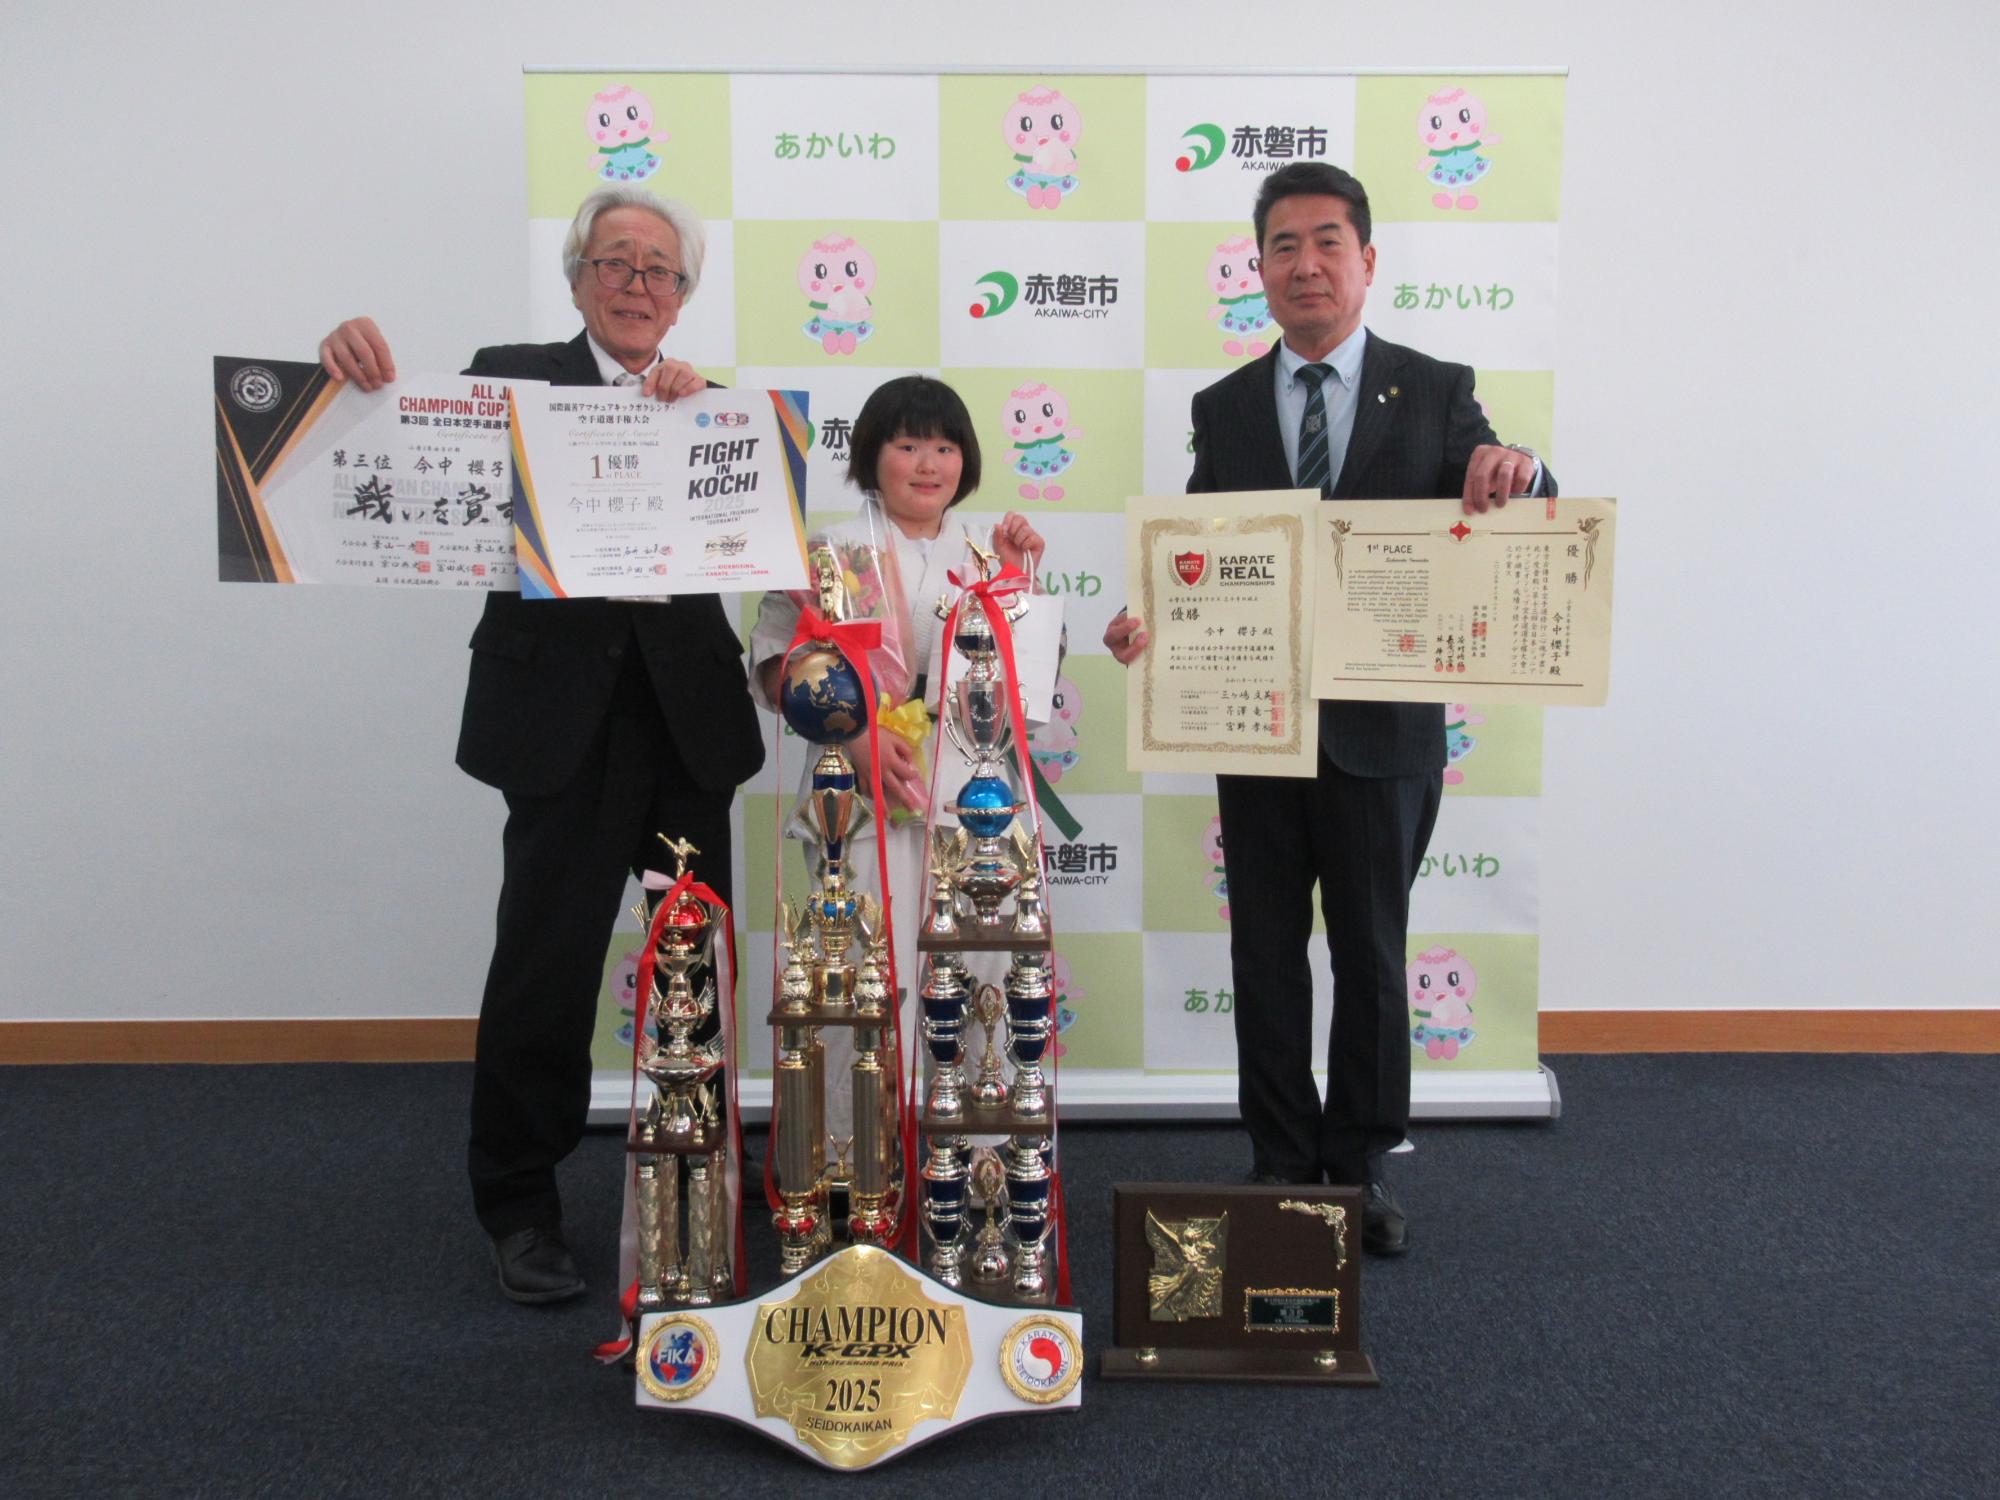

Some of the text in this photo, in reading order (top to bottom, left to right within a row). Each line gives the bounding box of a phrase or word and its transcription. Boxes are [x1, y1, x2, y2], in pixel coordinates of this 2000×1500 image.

[774, 132, 896, 159] あかいわ
[1231, 125, 1328, 158] 赤磐市
[1241, 161, 1286, 171] AKAIWA
[1024, 274, 1119, 306] 赤磐市
[1393, 283, 1514, 311] あかいわ
[1034, 308, 1109, 319] AKAIWA-CITY
[471, 384, 494, 400] ALL
[399, 396, 504, 417] CHAMPION CUP
[400, 415, 429, 426] 第3回
[578, 415, 650, 424] 空手道選手権大会
[689, 438, 760, 467] FIGHT
[333, 449, 392, 470] 第三位
[413, 456, 453, 476] 今中
[590, 454, 604, 479] 1
[614, 471, 642, 479] PLACE
[608, 455, 639, 470] 優勝
[716, 463, 731, 475] IN
[688, 471, 758, 500] KOCHI
[568, 496, 601, 513] 今中
[647, 496, 664, 511] 殿
[704, 494, 745, 513] 2025
[1367, 544, 1413, 554] 1st PLACE
[1220, 555, 1275, 565] KARATE
[1220, 567, 1275, 579] REAL
[1046, 571, 1102, 597] いわ
[1171, 607, 1200, 621] 優勝
[1419, 853, 1500, 878] かいわ
[1184, 989, 1234, 1013] あか
[765, 1305, 948, 1345] CHAMPION
[656, 1346, 698, 1365] FIKA
[824, 1378, 882, 1412] 2025
[807, 1416, 892, 1433] SEIDOKAIKAN
